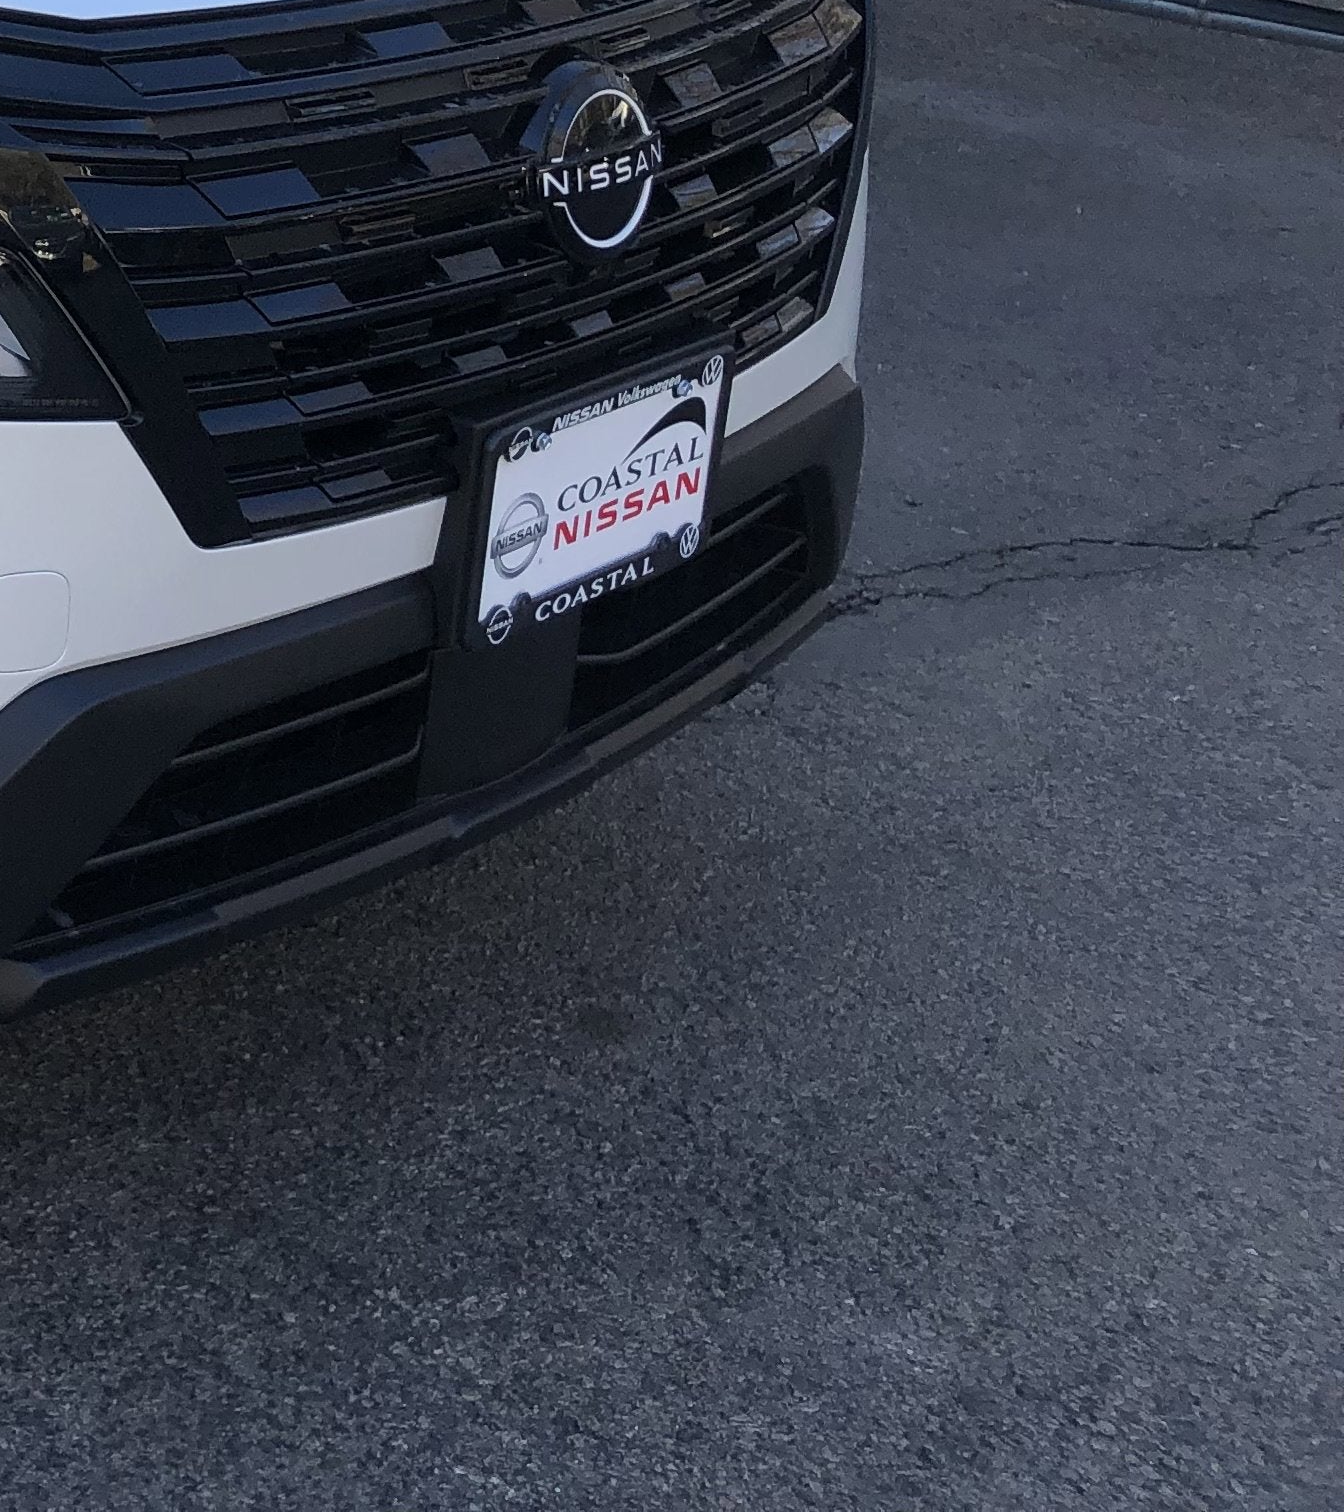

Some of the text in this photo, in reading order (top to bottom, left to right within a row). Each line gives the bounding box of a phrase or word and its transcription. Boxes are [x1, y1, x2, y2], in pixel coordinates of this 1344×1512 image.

[542, 138, 663, 198] NISSAN
[552, 374, 682, 432] NISSAN Volkswagen
[556, 436, 704, 513] COASTAL
[495, 520, 543, 551] NISSAN
[552, 467, 702, 551] NISSAN
[534, 556, 655, 622] COASTAL
